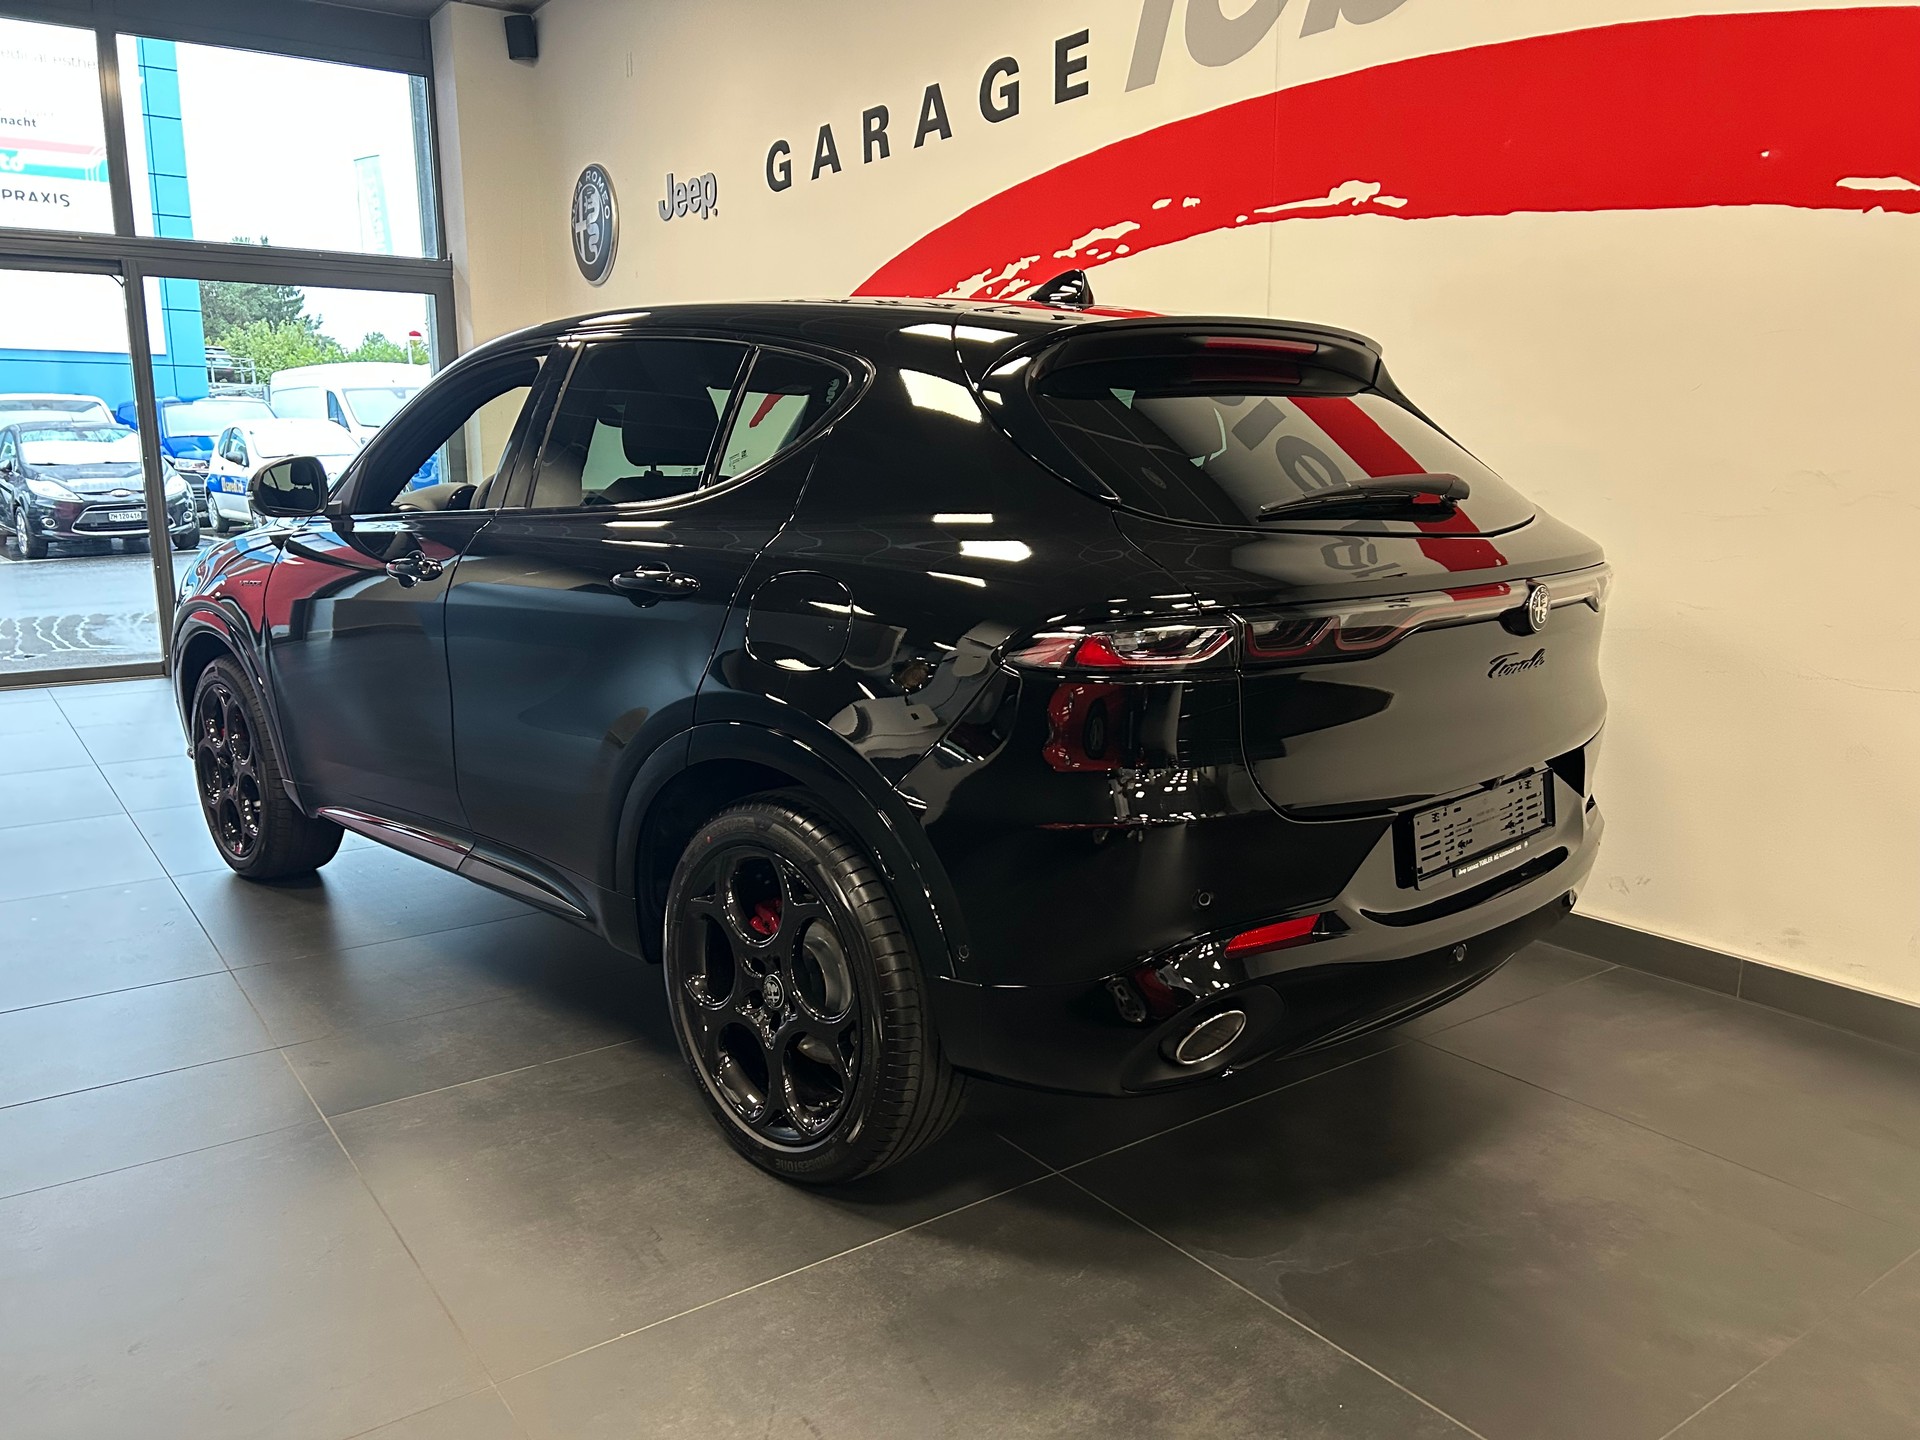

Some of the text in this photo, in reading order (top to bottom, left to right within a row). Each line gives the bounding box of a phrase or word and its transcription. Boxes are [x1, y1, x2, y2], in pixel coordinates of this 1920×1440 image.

[766, 28, 1090, 192] GARAGE
[1, 188, 70, 207] PRAXIS
[585, 170, 611, 220] ROMEO
